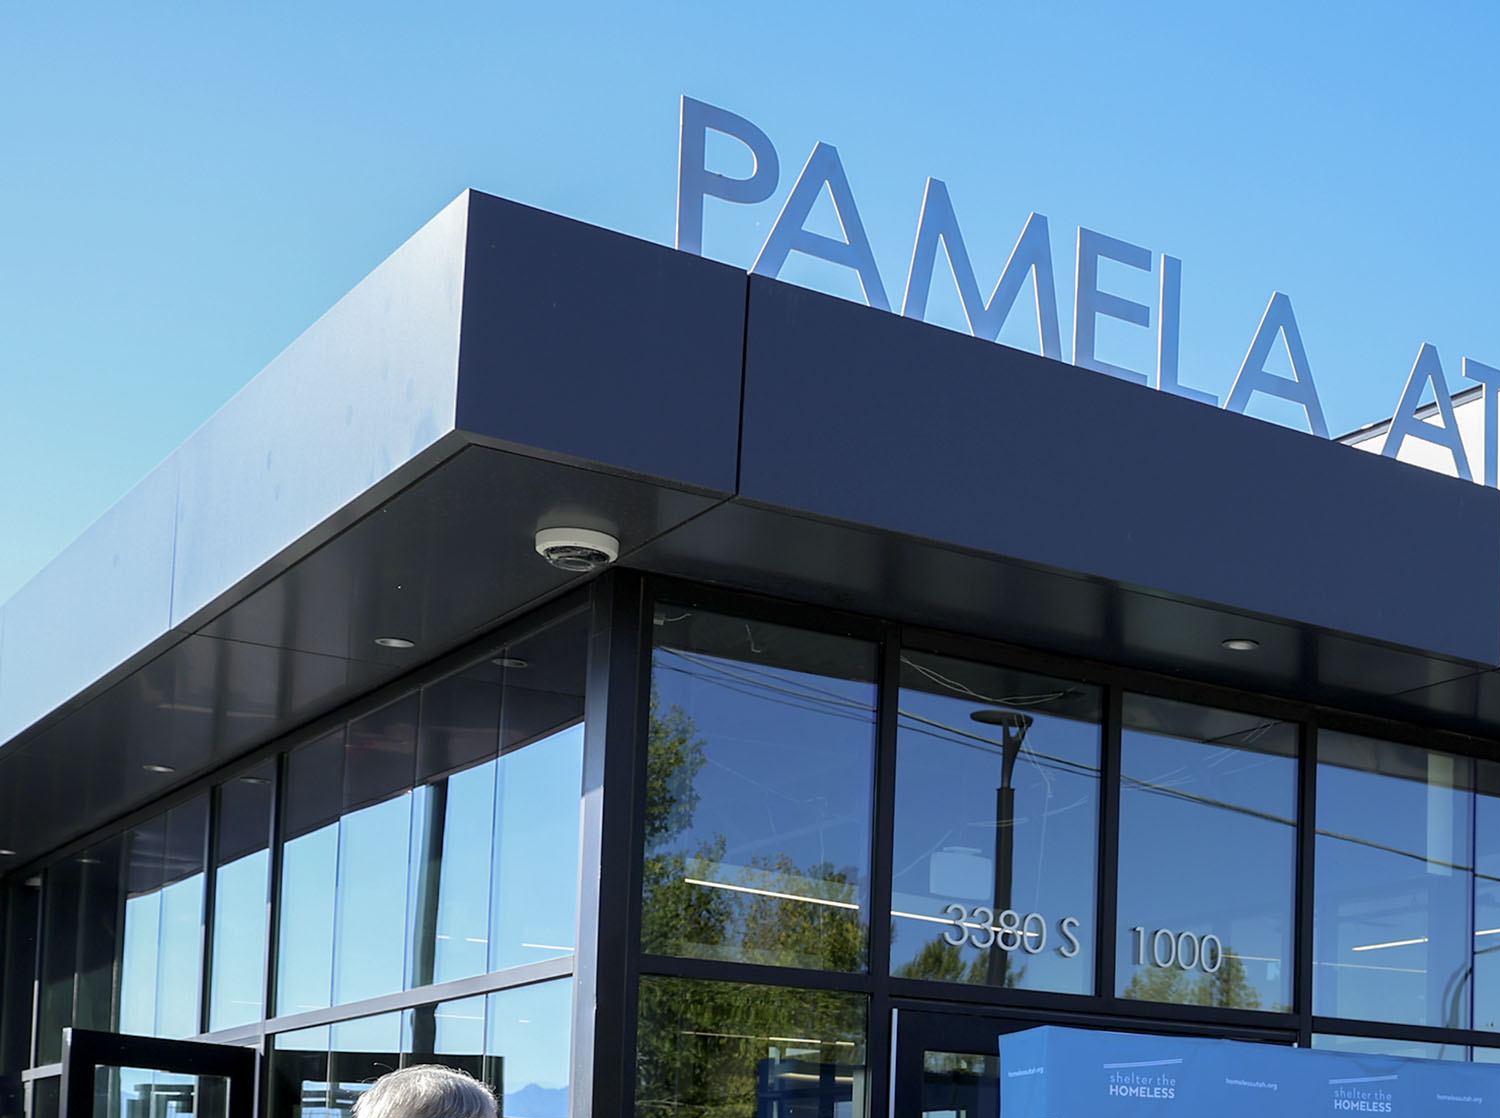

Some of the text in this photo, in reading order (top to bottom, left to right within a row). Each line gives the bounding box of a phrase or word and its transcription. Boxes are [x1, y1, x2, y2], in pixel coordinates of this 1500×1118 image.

[675, 93, 1332, 441] PAMELA
[943, 903, 1081, 960] 3380 S
[1131, 925, 1223, 974] 1000
[1109, 1071, 1177, 1087] shelter the
[1109, 1085, 1176, 1099] HOMELESS
[1334, 1087, 1392, 1101] shelter the
[1333, 1100, 1392, 1113] HOMELESS
